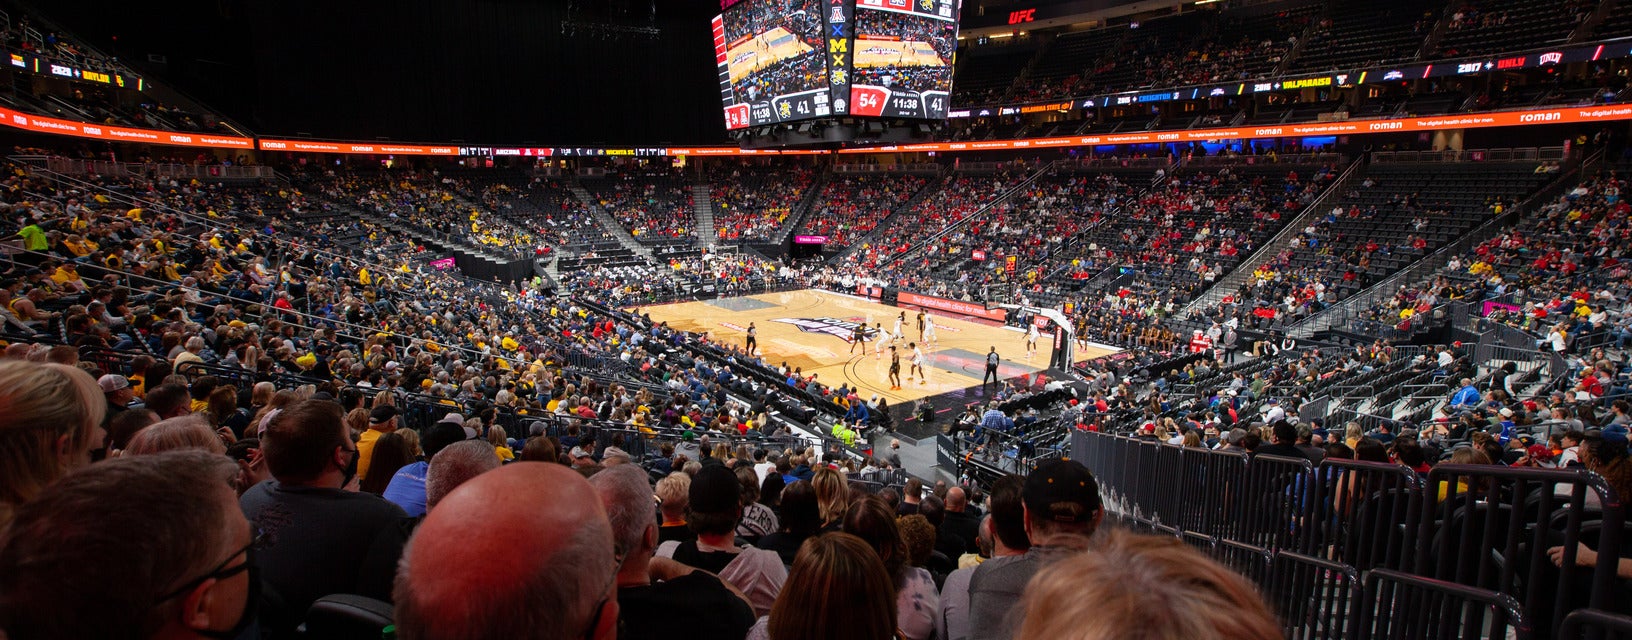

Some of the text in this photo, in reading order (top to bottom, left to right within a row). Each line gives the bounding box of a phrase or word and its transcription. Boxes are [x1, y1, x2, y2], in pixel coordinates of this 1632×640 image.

[1008, 8, 1036, 25] UFC
[829, 38, 847, 53] M
[1457, 57, 1526, 73] 2017 UNLV
[1539, 52, 1563, 66] UNLV
[1282, 77, 1332, 90] VALPARAISO
[859, 93, 877, 108] 54
[893, 98, 917, 109] 11:38
[1138, 92, 1171, 103] CREIGHTON
[796, 100, 811, 115] 41
[931, 98, 943, 111] 41
[732, 113, 739, 125] 54
[752, 107, 771, 121] 11:38
[1520, 111, 1561, 122] roman
[1591, 109, 1612, 118] digital
[1613, 108, 1632, 116] health
[1255, 127, 1283, 135] roman
[1369, 121, 1403, 130] roman
[170, 135, 192, 143] roman
[262, 141, 286, 149] roman
[1006, 261, 1015, 271] 22
[912, 295, 921, 303] The
[921, 297, 936, 306] digital
[936, 299, 952, 309] health
[951, 302, 965, 311] clinic
